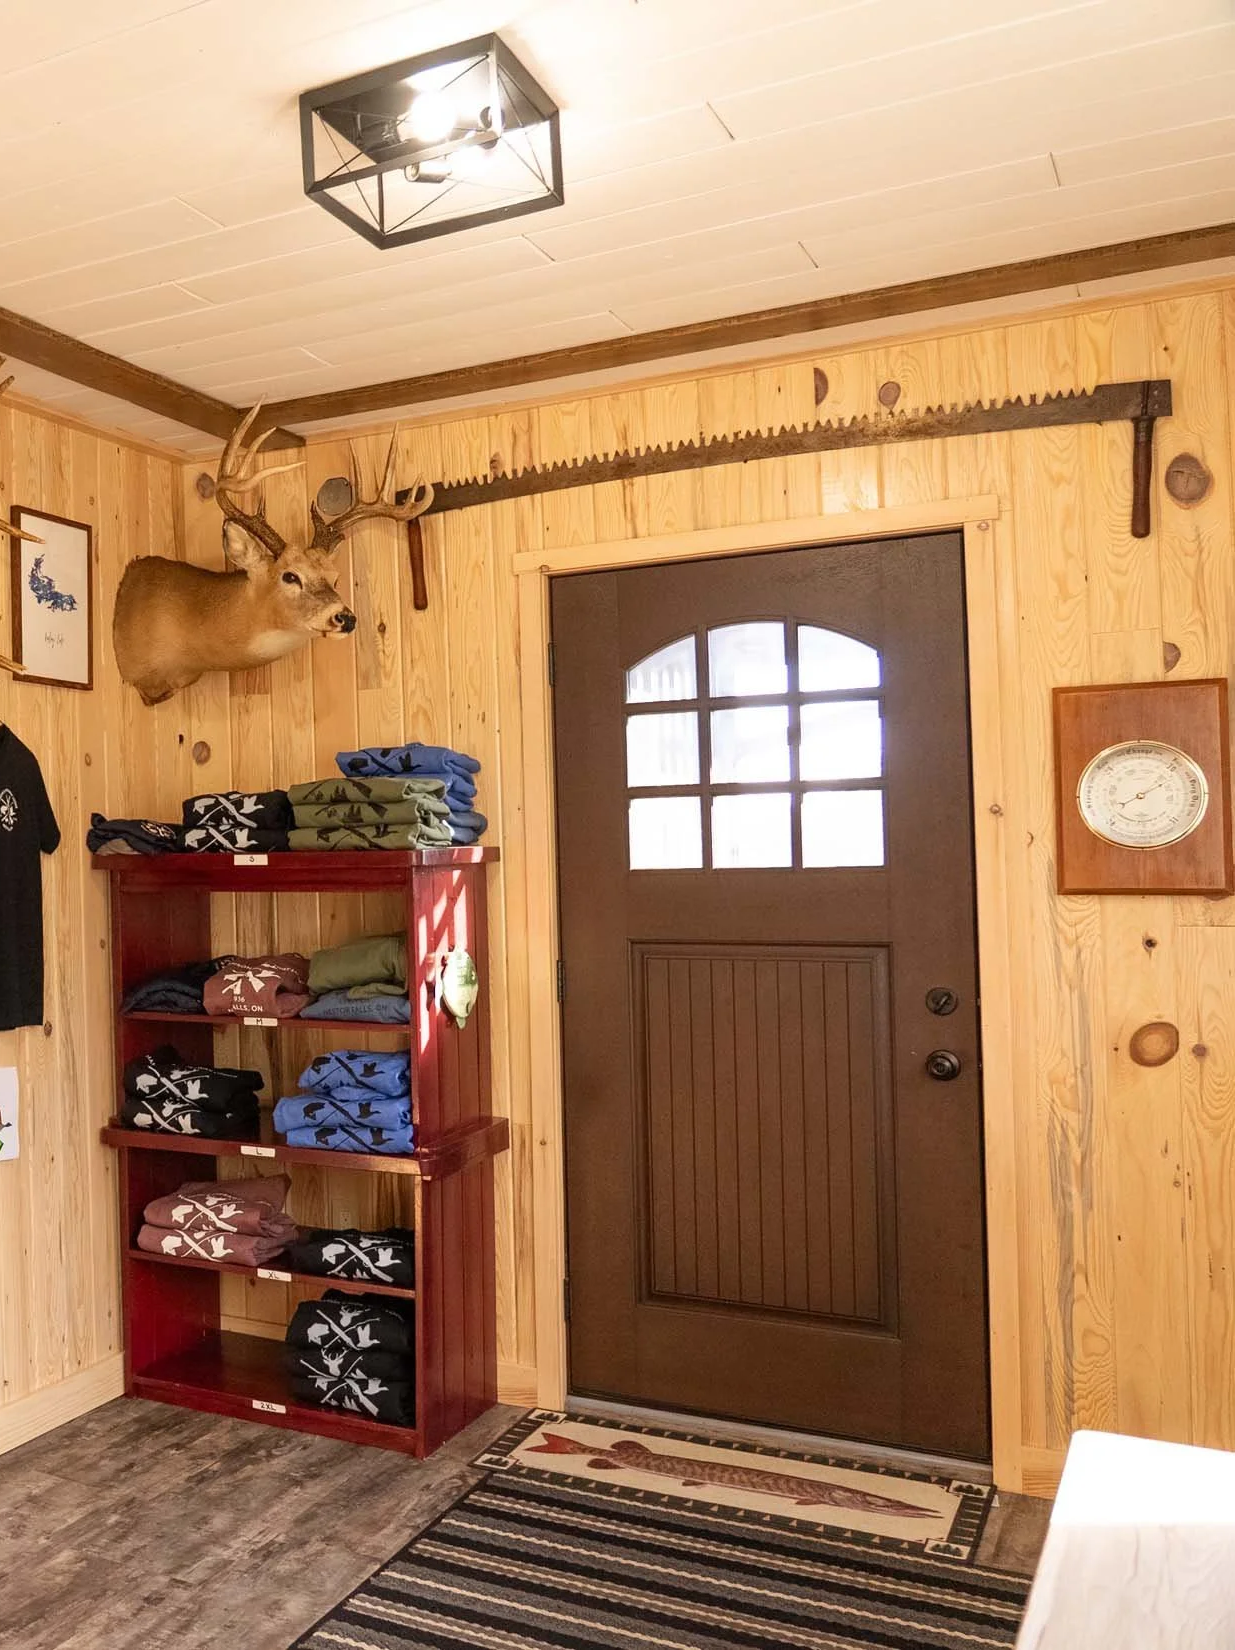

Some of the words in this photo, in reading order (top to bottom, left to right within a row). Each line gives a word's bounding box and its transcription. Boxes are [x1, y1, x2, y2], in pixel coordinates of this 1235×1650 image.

[255, 1146, 263, 1156] L
[268, 1271, 281, 1280] XL
[260, 1402, 277, 1412] 2XL
